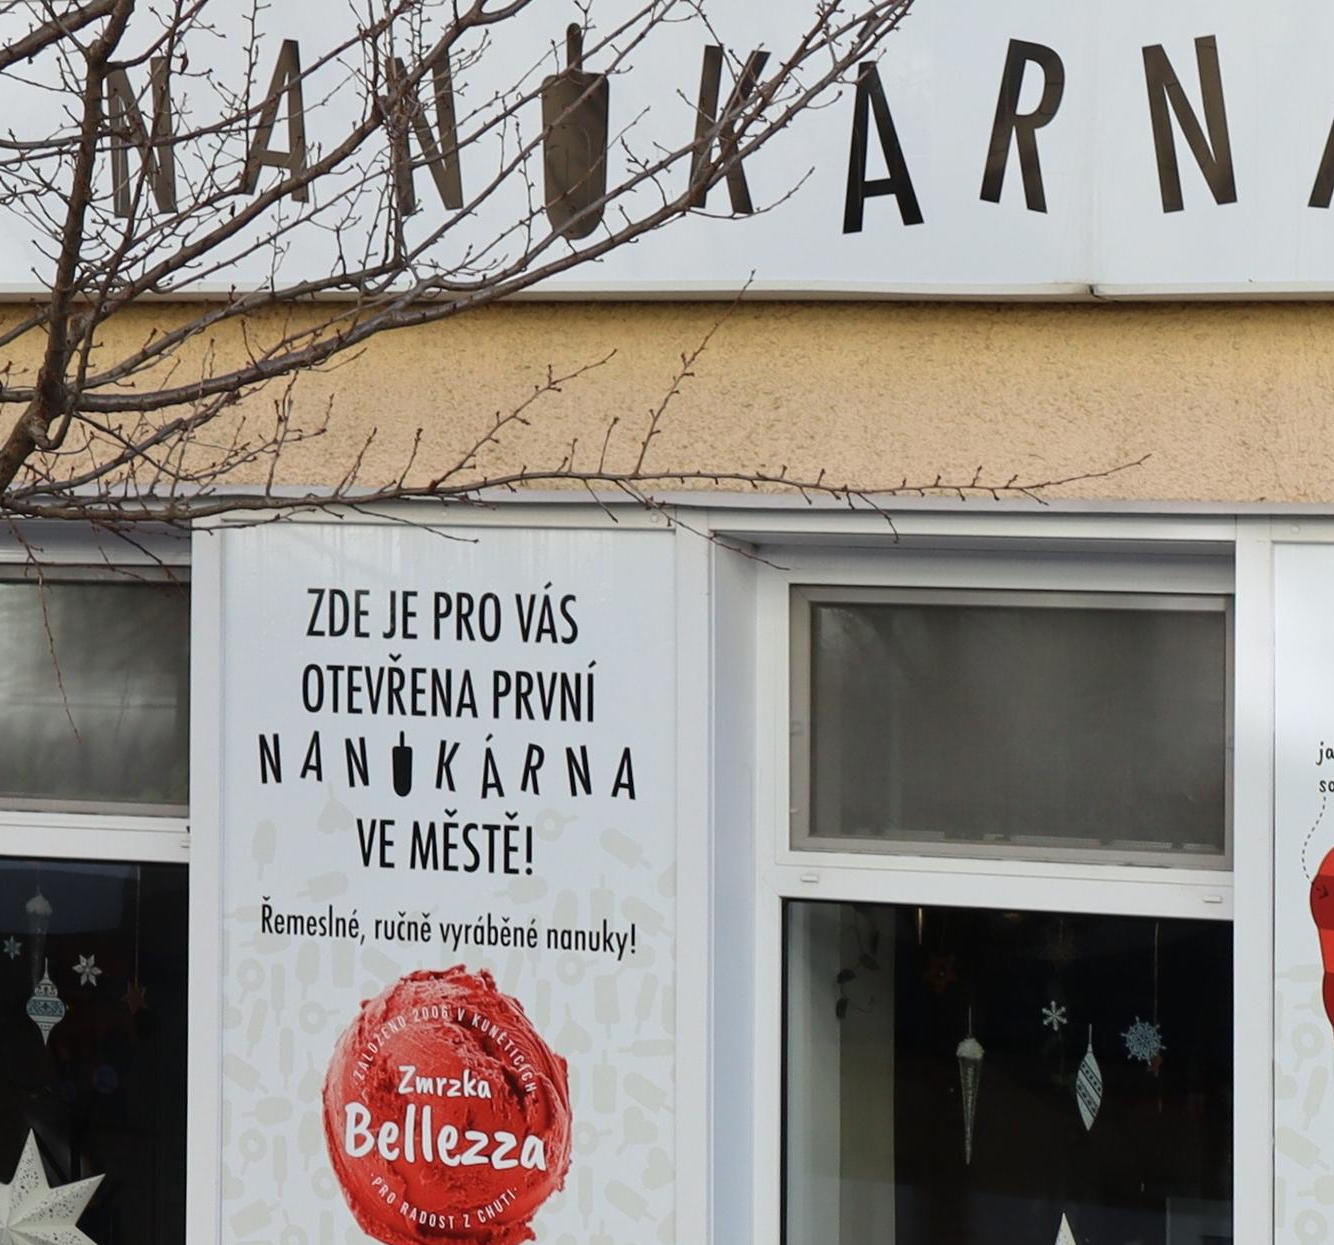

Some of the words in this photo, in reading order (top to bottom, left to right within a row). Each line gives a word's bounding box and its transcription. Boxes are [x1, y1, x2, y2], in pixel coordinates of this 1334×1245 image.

[306, 588, 370, 638] ZDE
[382, 590, 418, 640] JE
[434, 591, 502, 643] PRO
[515, 581, 579, 645] VÁS
[302, 653, 479, 719] OTEVŘENA
[493, 660, 597, 723] PRVNÍ
[356, 818, 395, 869] VE
[409, 808, 533, 876] MĚSTĚ!
[261, 896, 365, 945] Řemeslné,
[375, 911, 432, 943] ručně
[439, 912, 538, 952] vyráběné
[547, 919, 636, 961] nanuky!
[413, 1005, 449, 1023] 2006
[457, 1007, 466, 1022] V
[398, 1065, 491, 1098] Zmrzka
[344, 1102, 547, 1172] Bellezza
[400, 1203, 455, 1230] RADOST
[463, 1213, 471, 1228] Z
